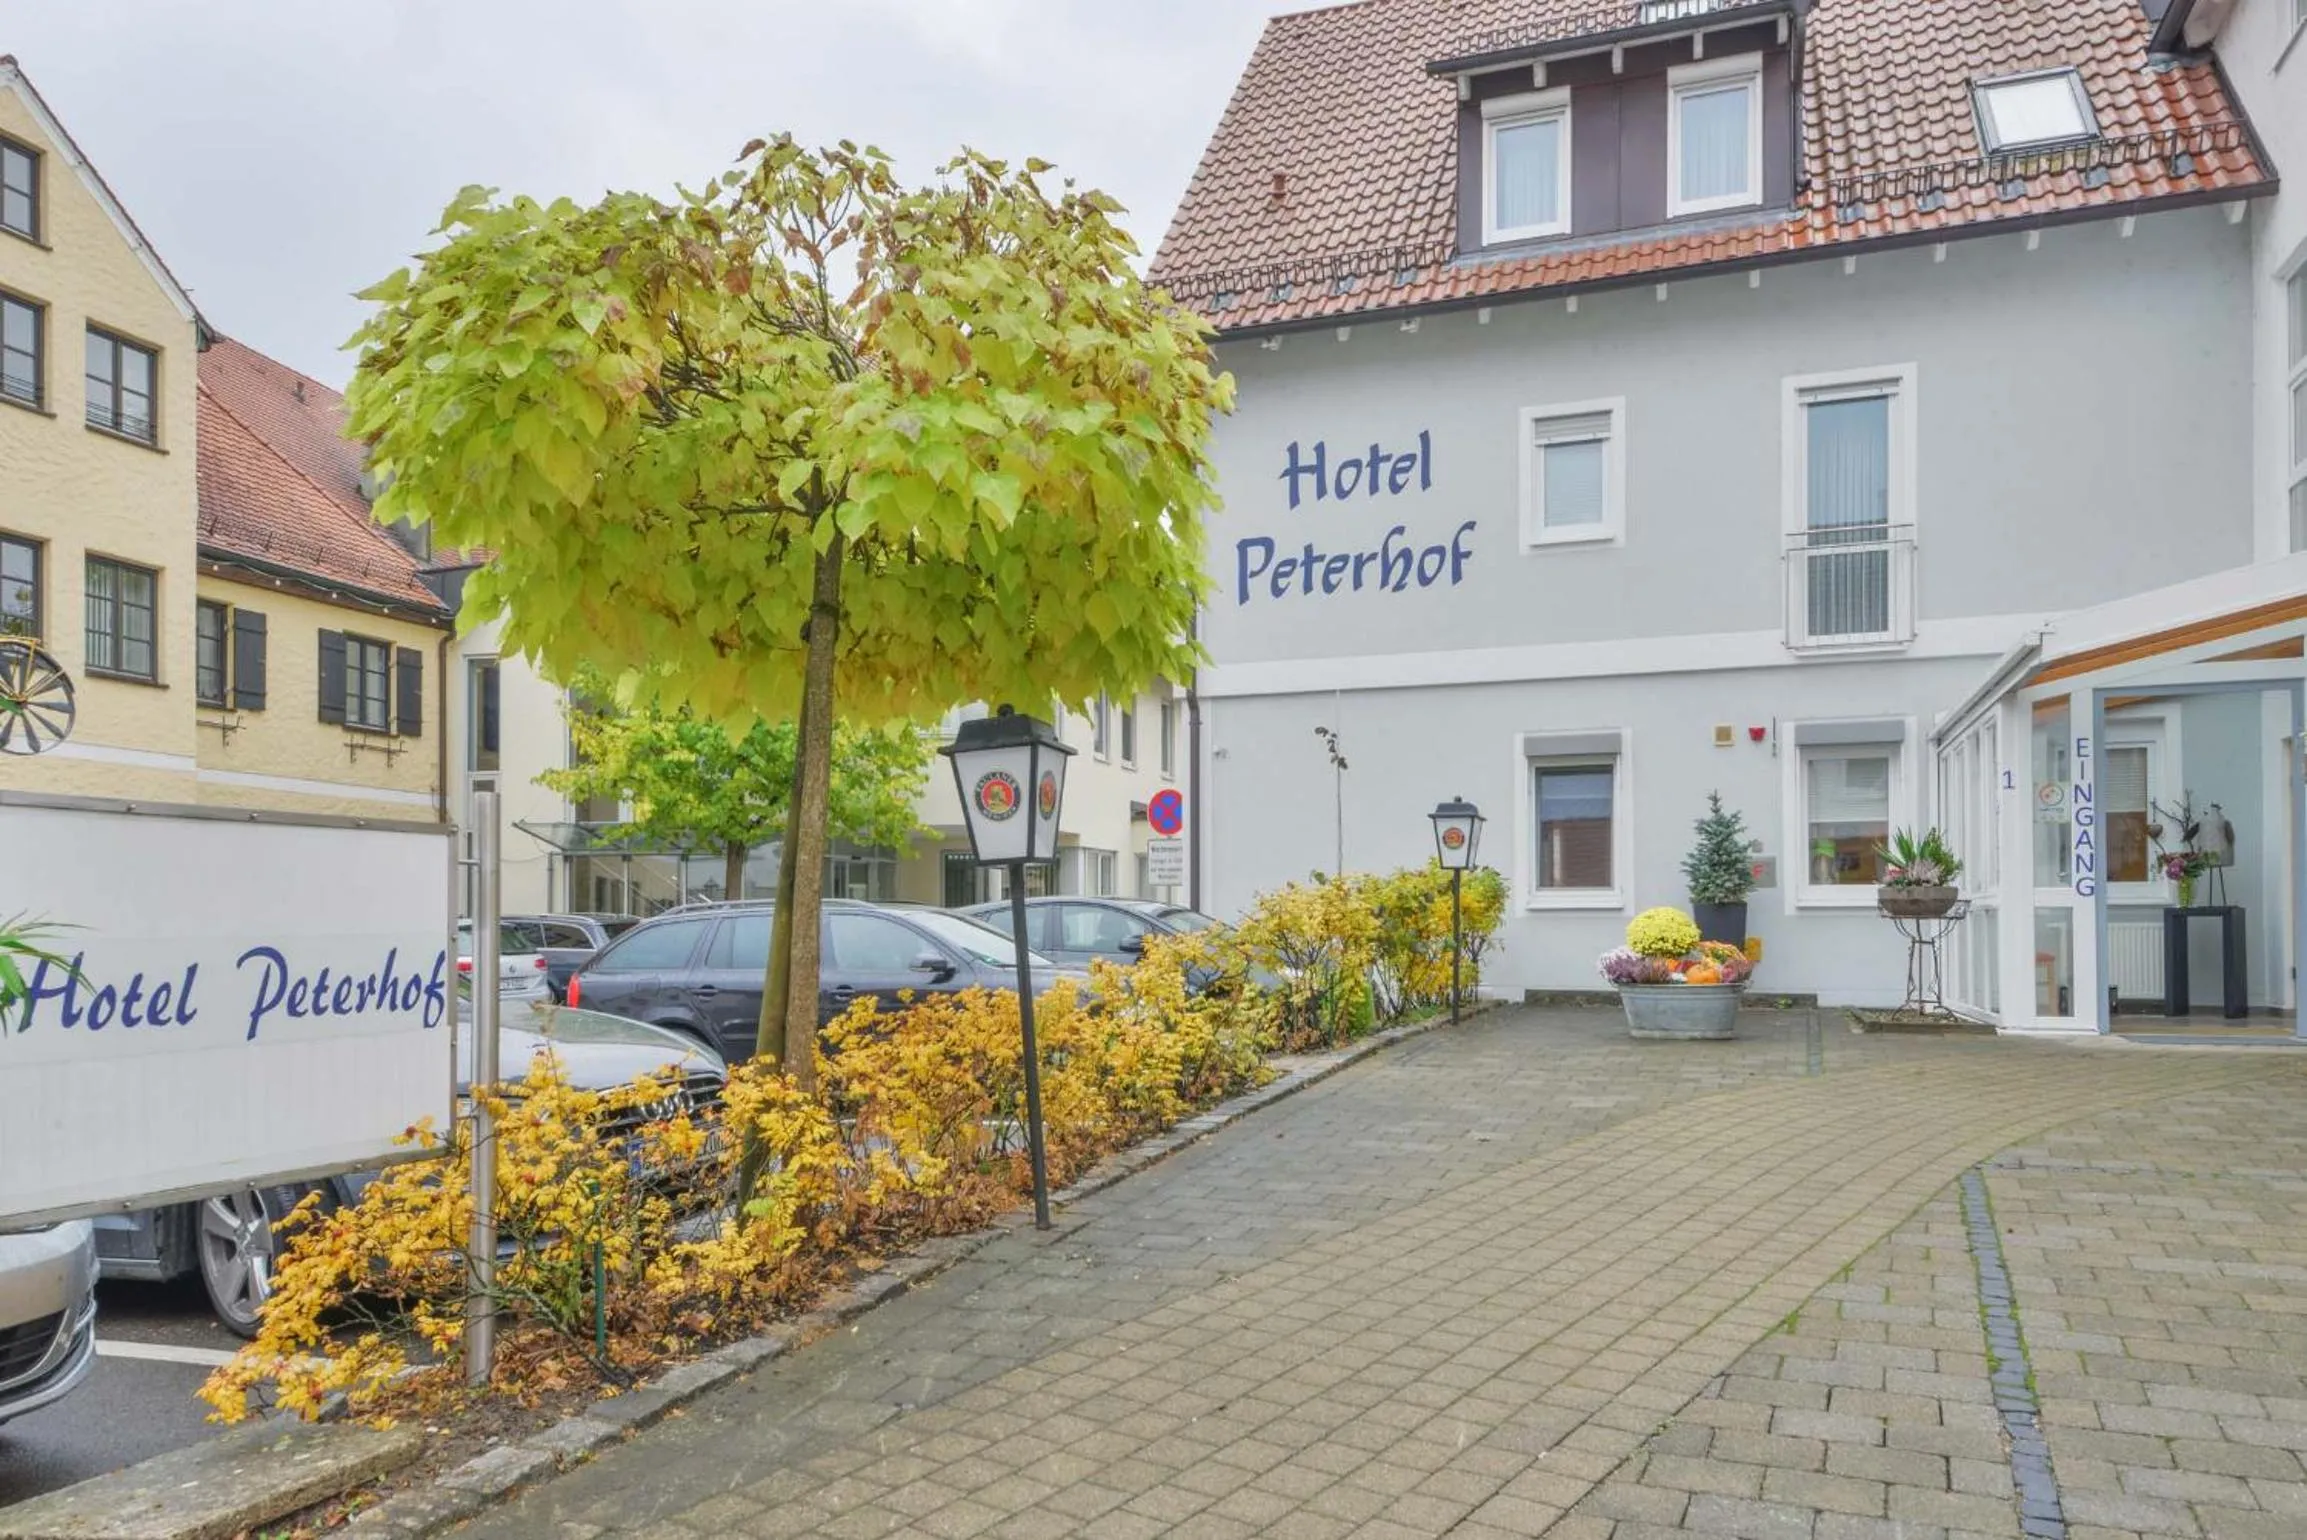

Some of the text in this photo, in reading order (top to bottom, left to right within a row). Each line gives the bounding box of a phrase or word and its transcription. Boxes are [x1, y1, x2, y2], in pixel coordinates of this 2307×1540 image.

[1279, 429, 1433, 510] Hotel
[1236, 520, 1477, 607] Peterhof
[2003, 770, 2015, 790] 1
[2074, 738, 2095, 898] EINGANG
[11, 945, 446, 1041] Hotel Peterhof
